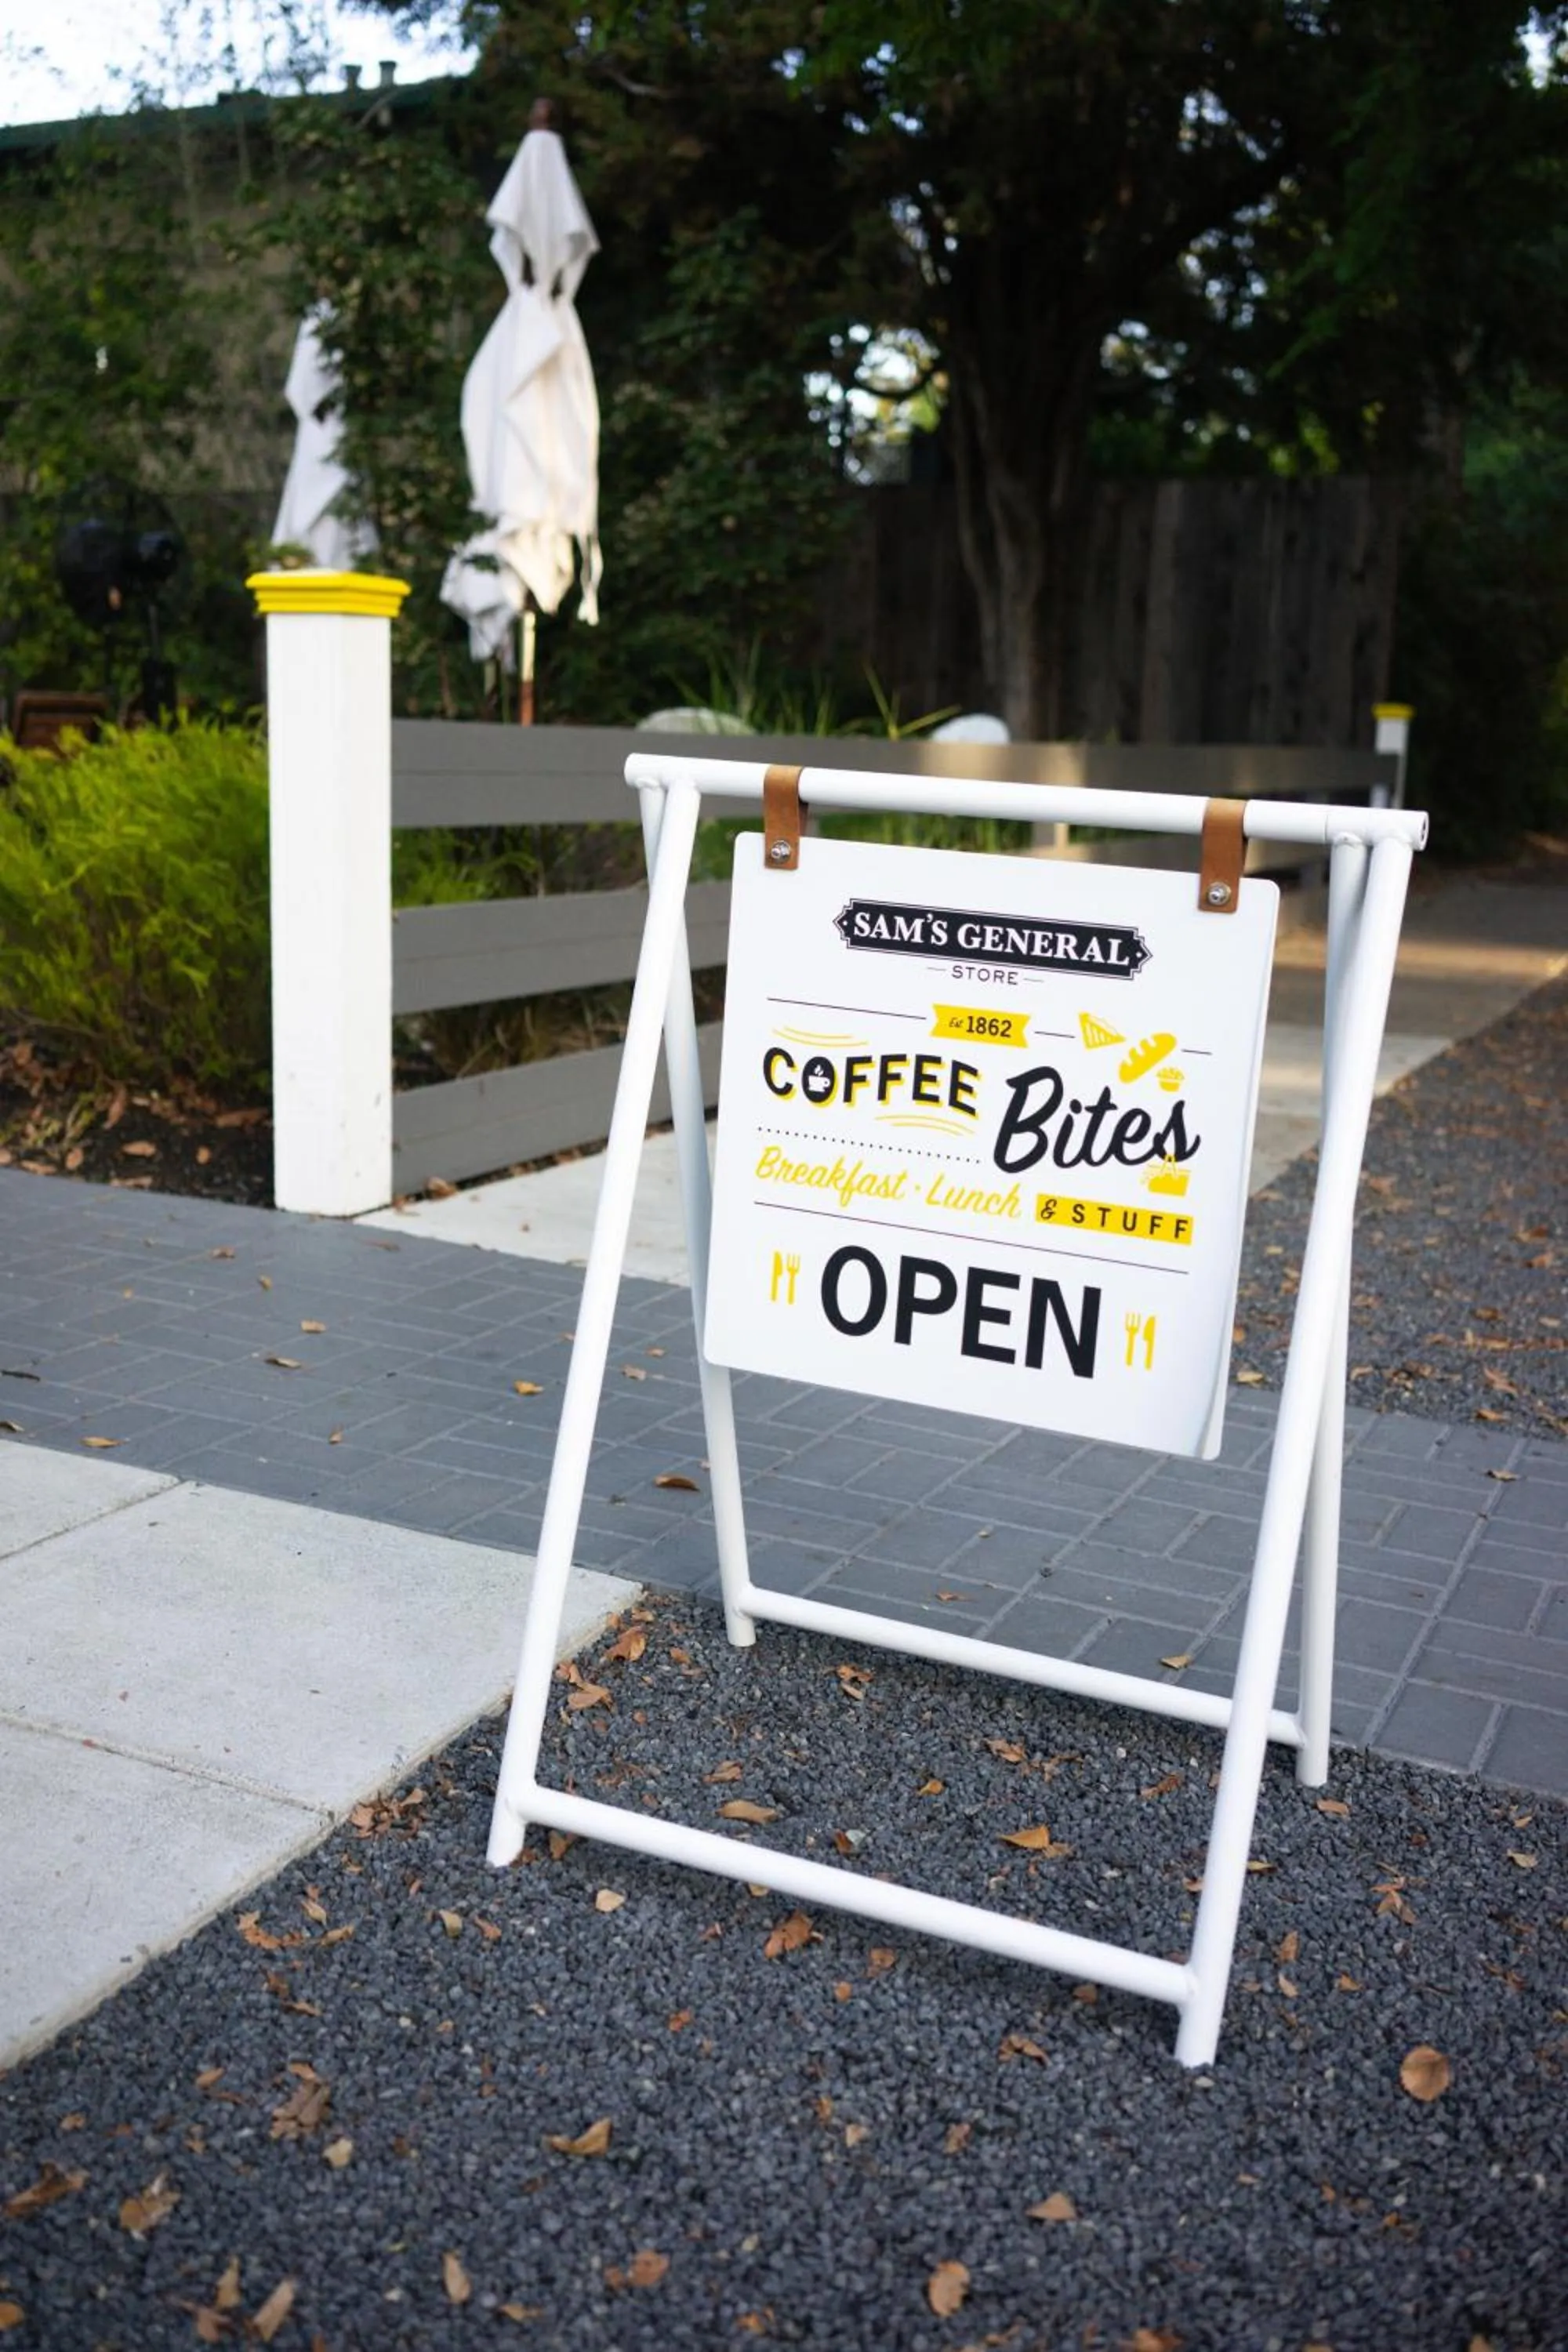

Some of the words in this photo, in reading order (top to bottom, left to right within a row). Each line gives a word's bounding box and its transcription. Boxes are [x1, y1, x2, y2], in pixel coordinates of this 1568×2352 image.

[853, 912, 949, 946] SAM'S
[956, 924, 1130, 967] GENERAL
[952, 965, 1019, 985] STORE
[966, 1015, 1012, 1038] 1862
[763, 1047, 980, 1120] COFFEE
[993, 1065, 1201, 1174] Bites
[755, 1145, 908, 1208] Breakfast
[924, 1172, 1021, 1218] Lunch
[1040, 1199, 1058, 1220] &
[1072, 1203, 1189, 1239] STUFF
[821, 1244, 1102, 1380] OPEN
